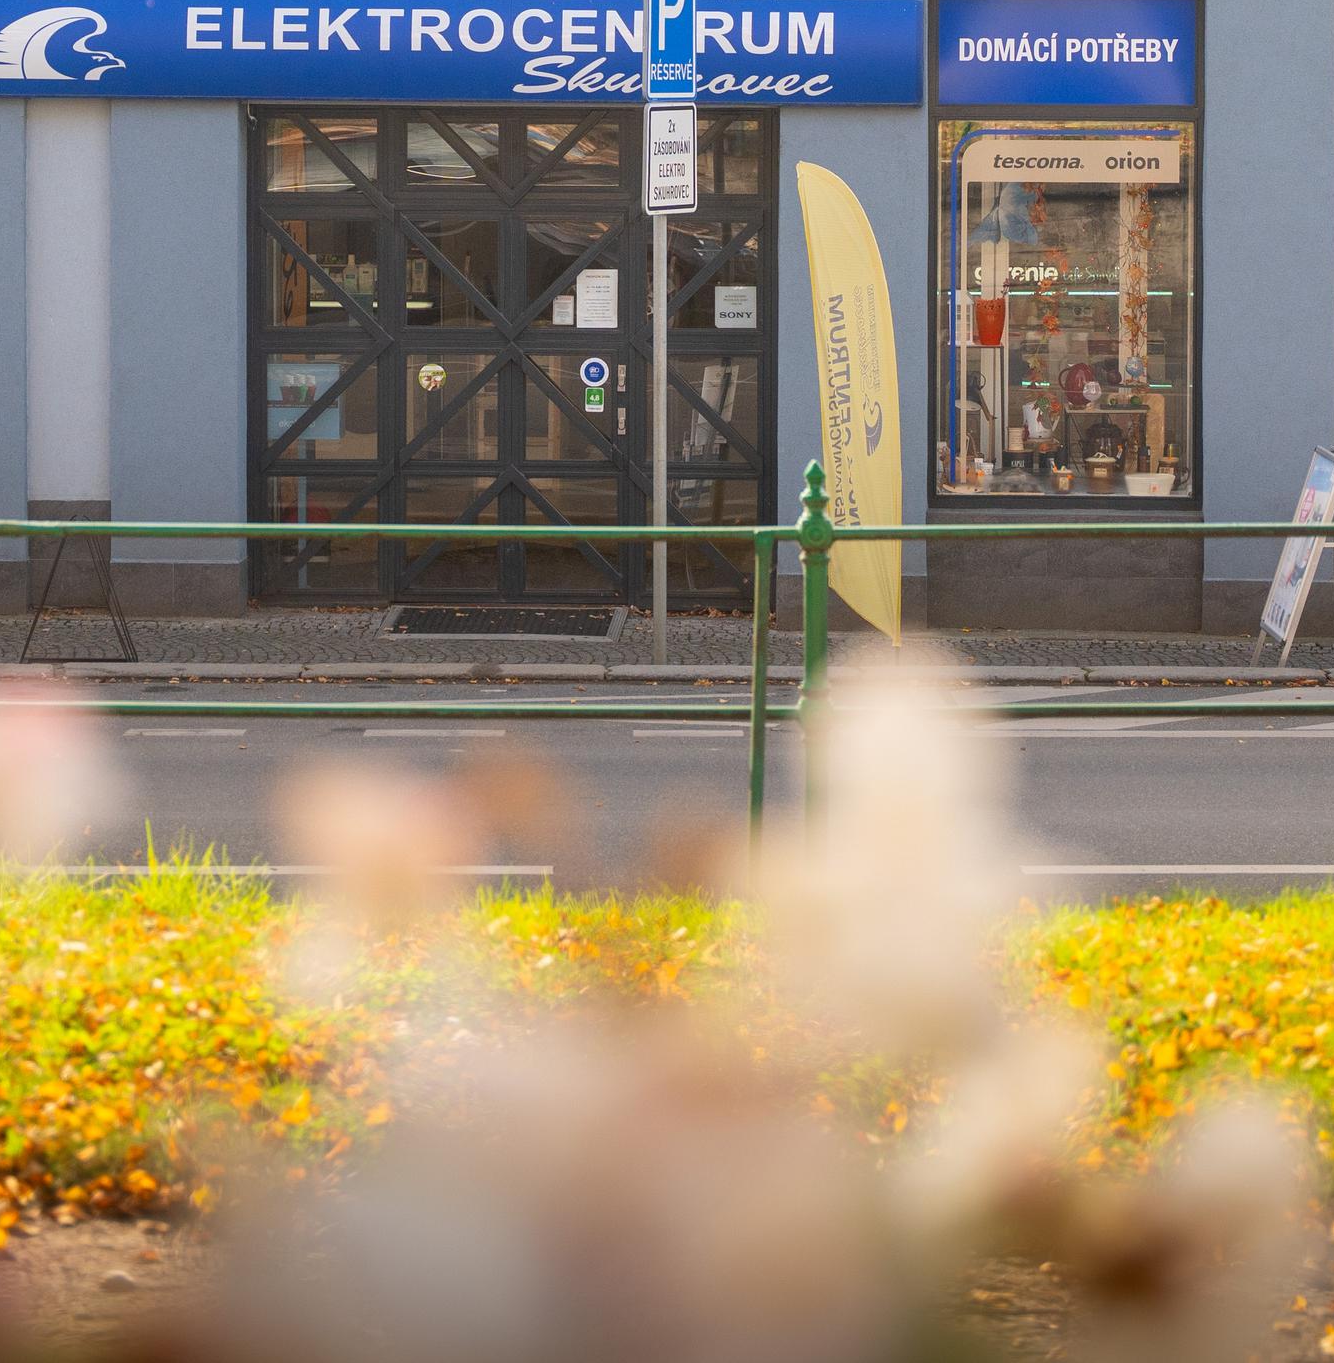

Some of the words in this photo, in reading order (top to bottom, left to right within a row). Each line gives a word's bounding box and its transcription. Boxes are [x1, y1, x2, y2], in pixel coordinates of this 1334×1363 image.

[186, 6, 835, 55] ELEKTROCENRUM
[959, 32, 1058, 63] DOMÁCÍ
[1065, 32, 1179, 63] POTŘEBY
[512, 54, 834, 97] Skuovec
[651, 59, 693, 81] RÉSERVÉ
[668, 119, 676, 133] 2x
[653, 137, 691, 156] ZÁSOBOVÁNÍ
[993, 154, 1080, 169] tescoma
[1105, 150, 1160, 170] orion
[659, 163, 686, 178] ELEKTRO
[653, 185, 690, 201] SKUHROVEC
[974, 262, 1059, 284] enje
[719, 311, 753, 319] SONY
